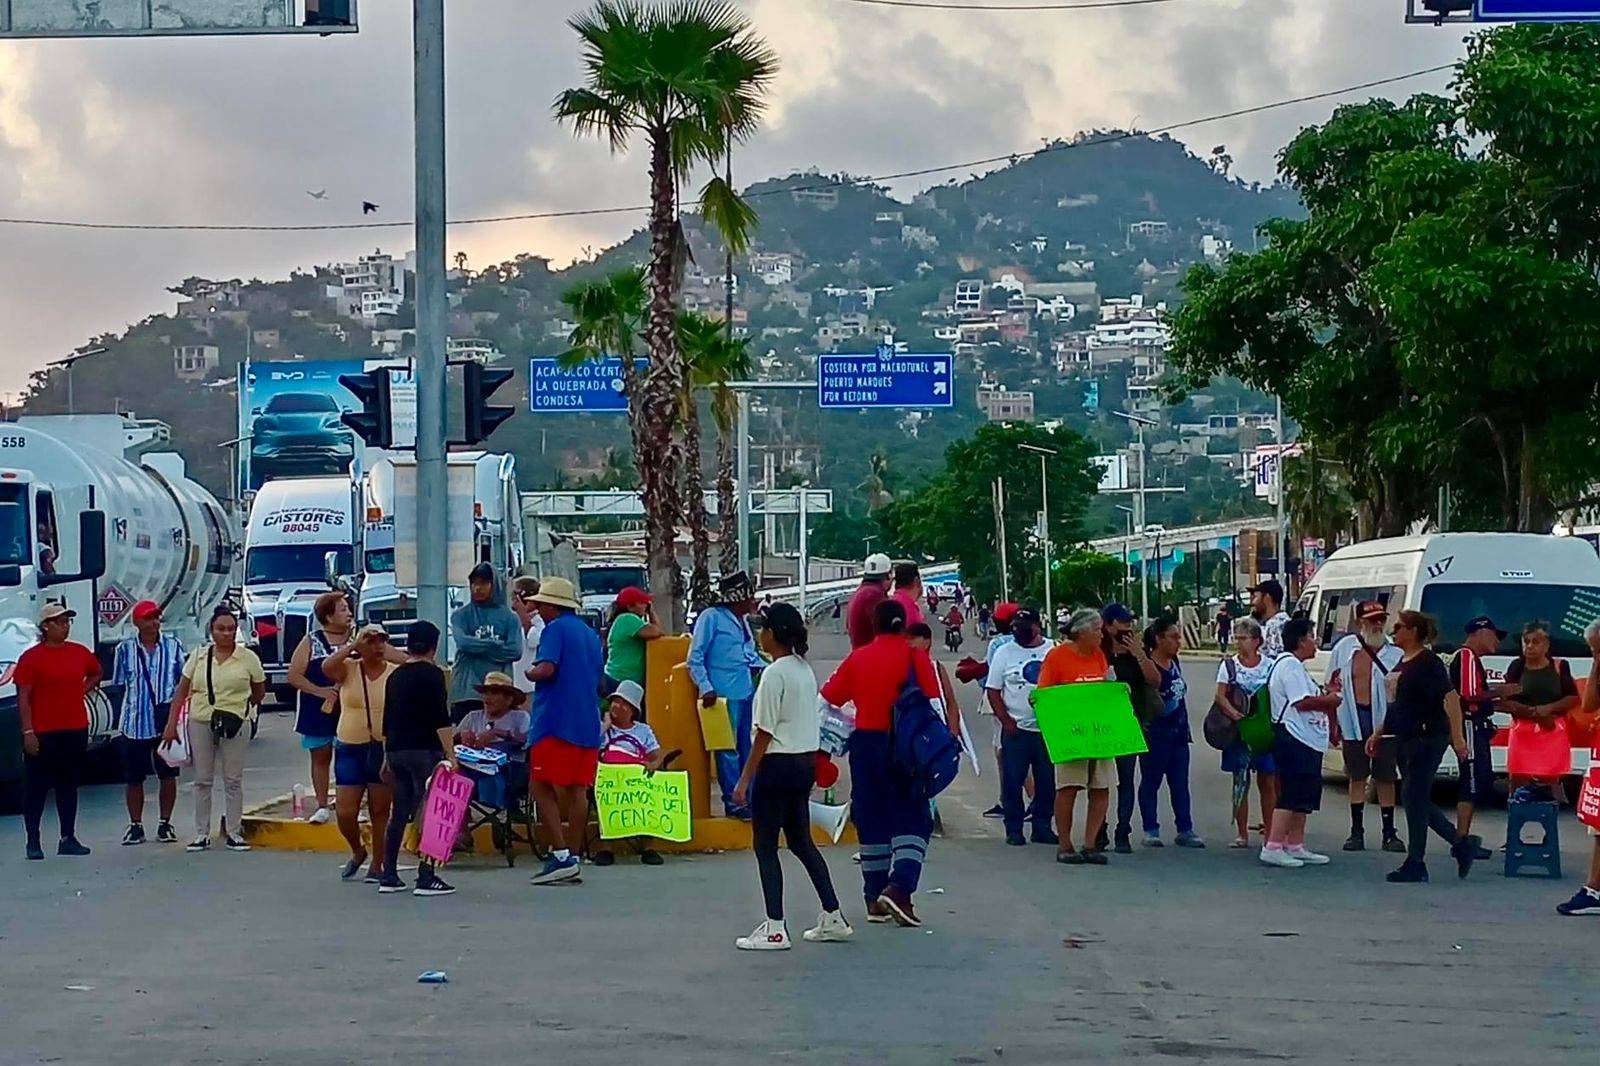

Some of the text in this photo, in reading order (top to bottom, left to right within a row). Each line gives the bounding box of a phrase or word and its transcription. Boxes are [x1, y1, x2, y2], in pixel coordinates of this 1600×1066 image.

[824, 362, 929, 373] COSTERA POR MACROTUNEL
[271, 372, 304, 380] BYD
[536, 381, 607, 391] LA QUEBRADA
[824, 376, 892, 388] PUERTO MARQUES
[536, 395, 584, 406] CONDESA
[824, 391, 878, 402] POR RETORNO
[1, 437, 26, 448] 558
[263, 512, 345, 527] CASTORES
[662, 798, 689, 815] DEL
[608, 808, 673, 834] CENSO
